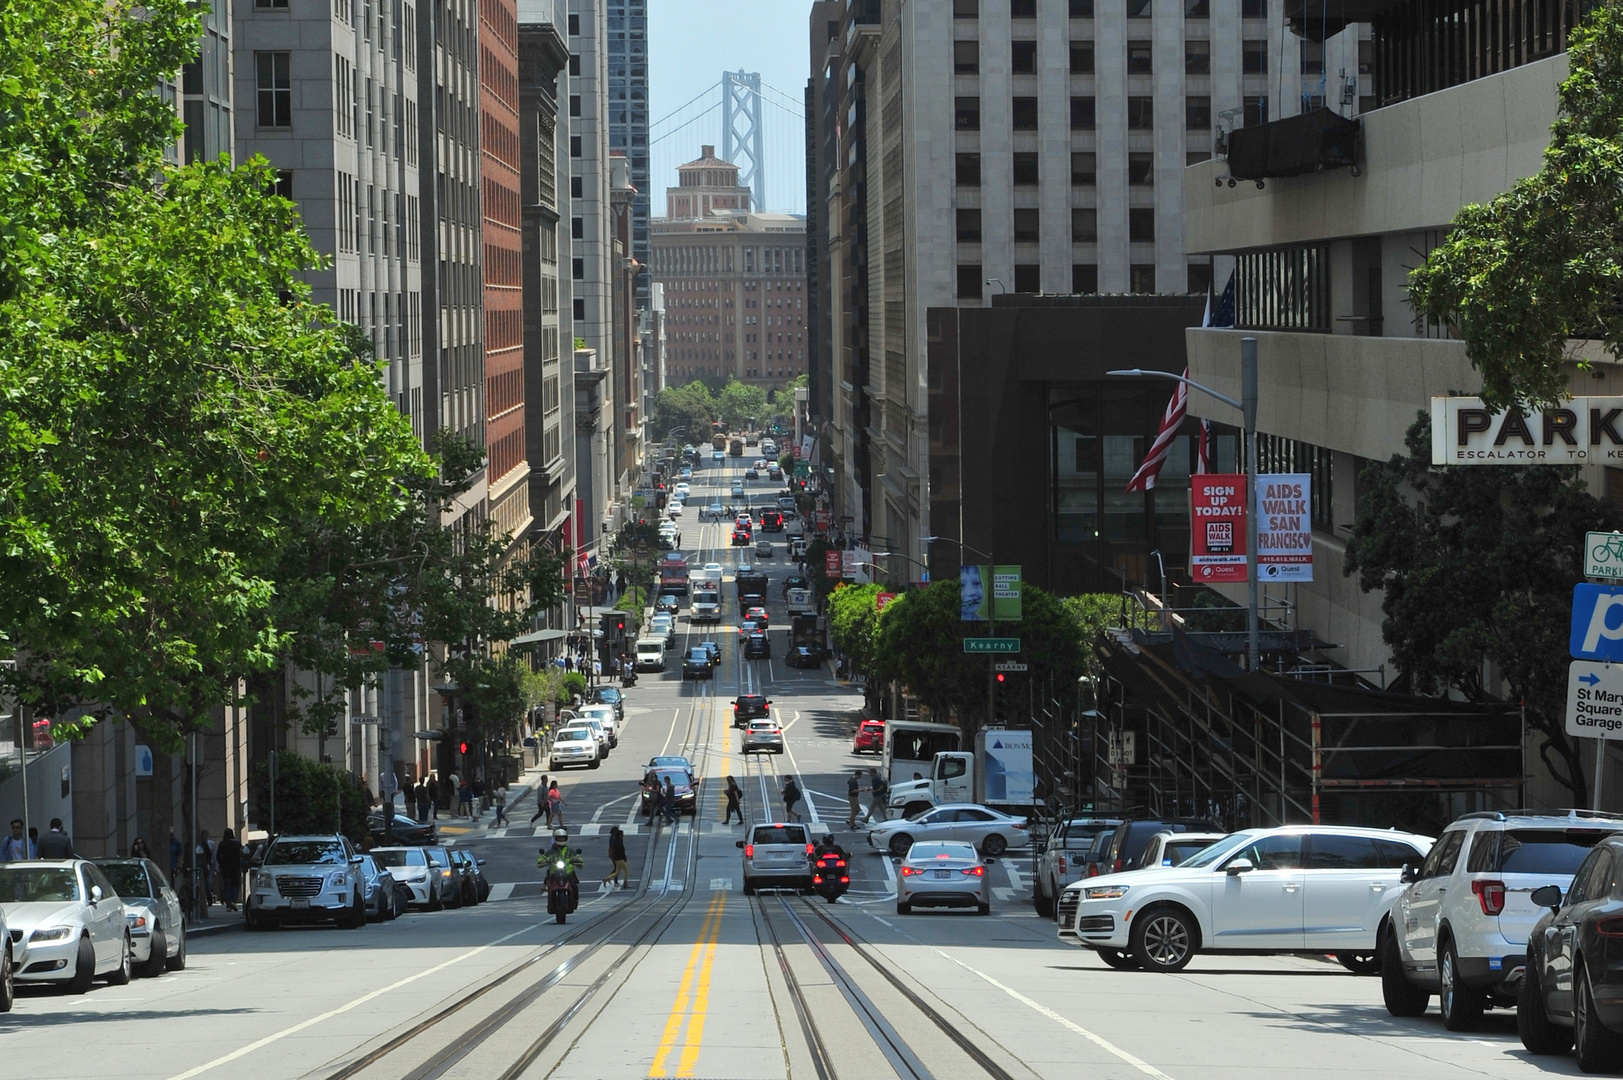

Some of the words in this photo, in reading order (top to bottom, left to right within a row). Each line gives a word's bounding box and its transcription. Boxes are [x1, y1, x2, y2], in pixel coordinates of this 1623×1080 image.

[1457, 408, 1623, 446] PARK
[1457, 450, 1546, 459] ESCALATOR
[1567, 450, 1587, 459] TO
[1607, 450, 1623, 459] KE
[1203, 486, 1235, 496] SIGN
[1266, 483, 1303, 499] AIDS
[1210, 496, 1228, 506] UP
[1195, 506, 1242, 516] TODAY!
[1262, 500, 1307, 515] WALK
[1208, 524, 1231, 533] AIDS
[1269, 516, 1301, 531] SAN
[1208, 532, 1231, 540] WALK
[1592, 565, 1622, 576] PARKI
[693, 581, 718, 590] FedEx
[970, 641, 1013, 651] Kearny
[1577, 688, 1591, 700] St
[1576, 701, 1622, 716] Square
[1576, 714, 1623, 731] Garage
